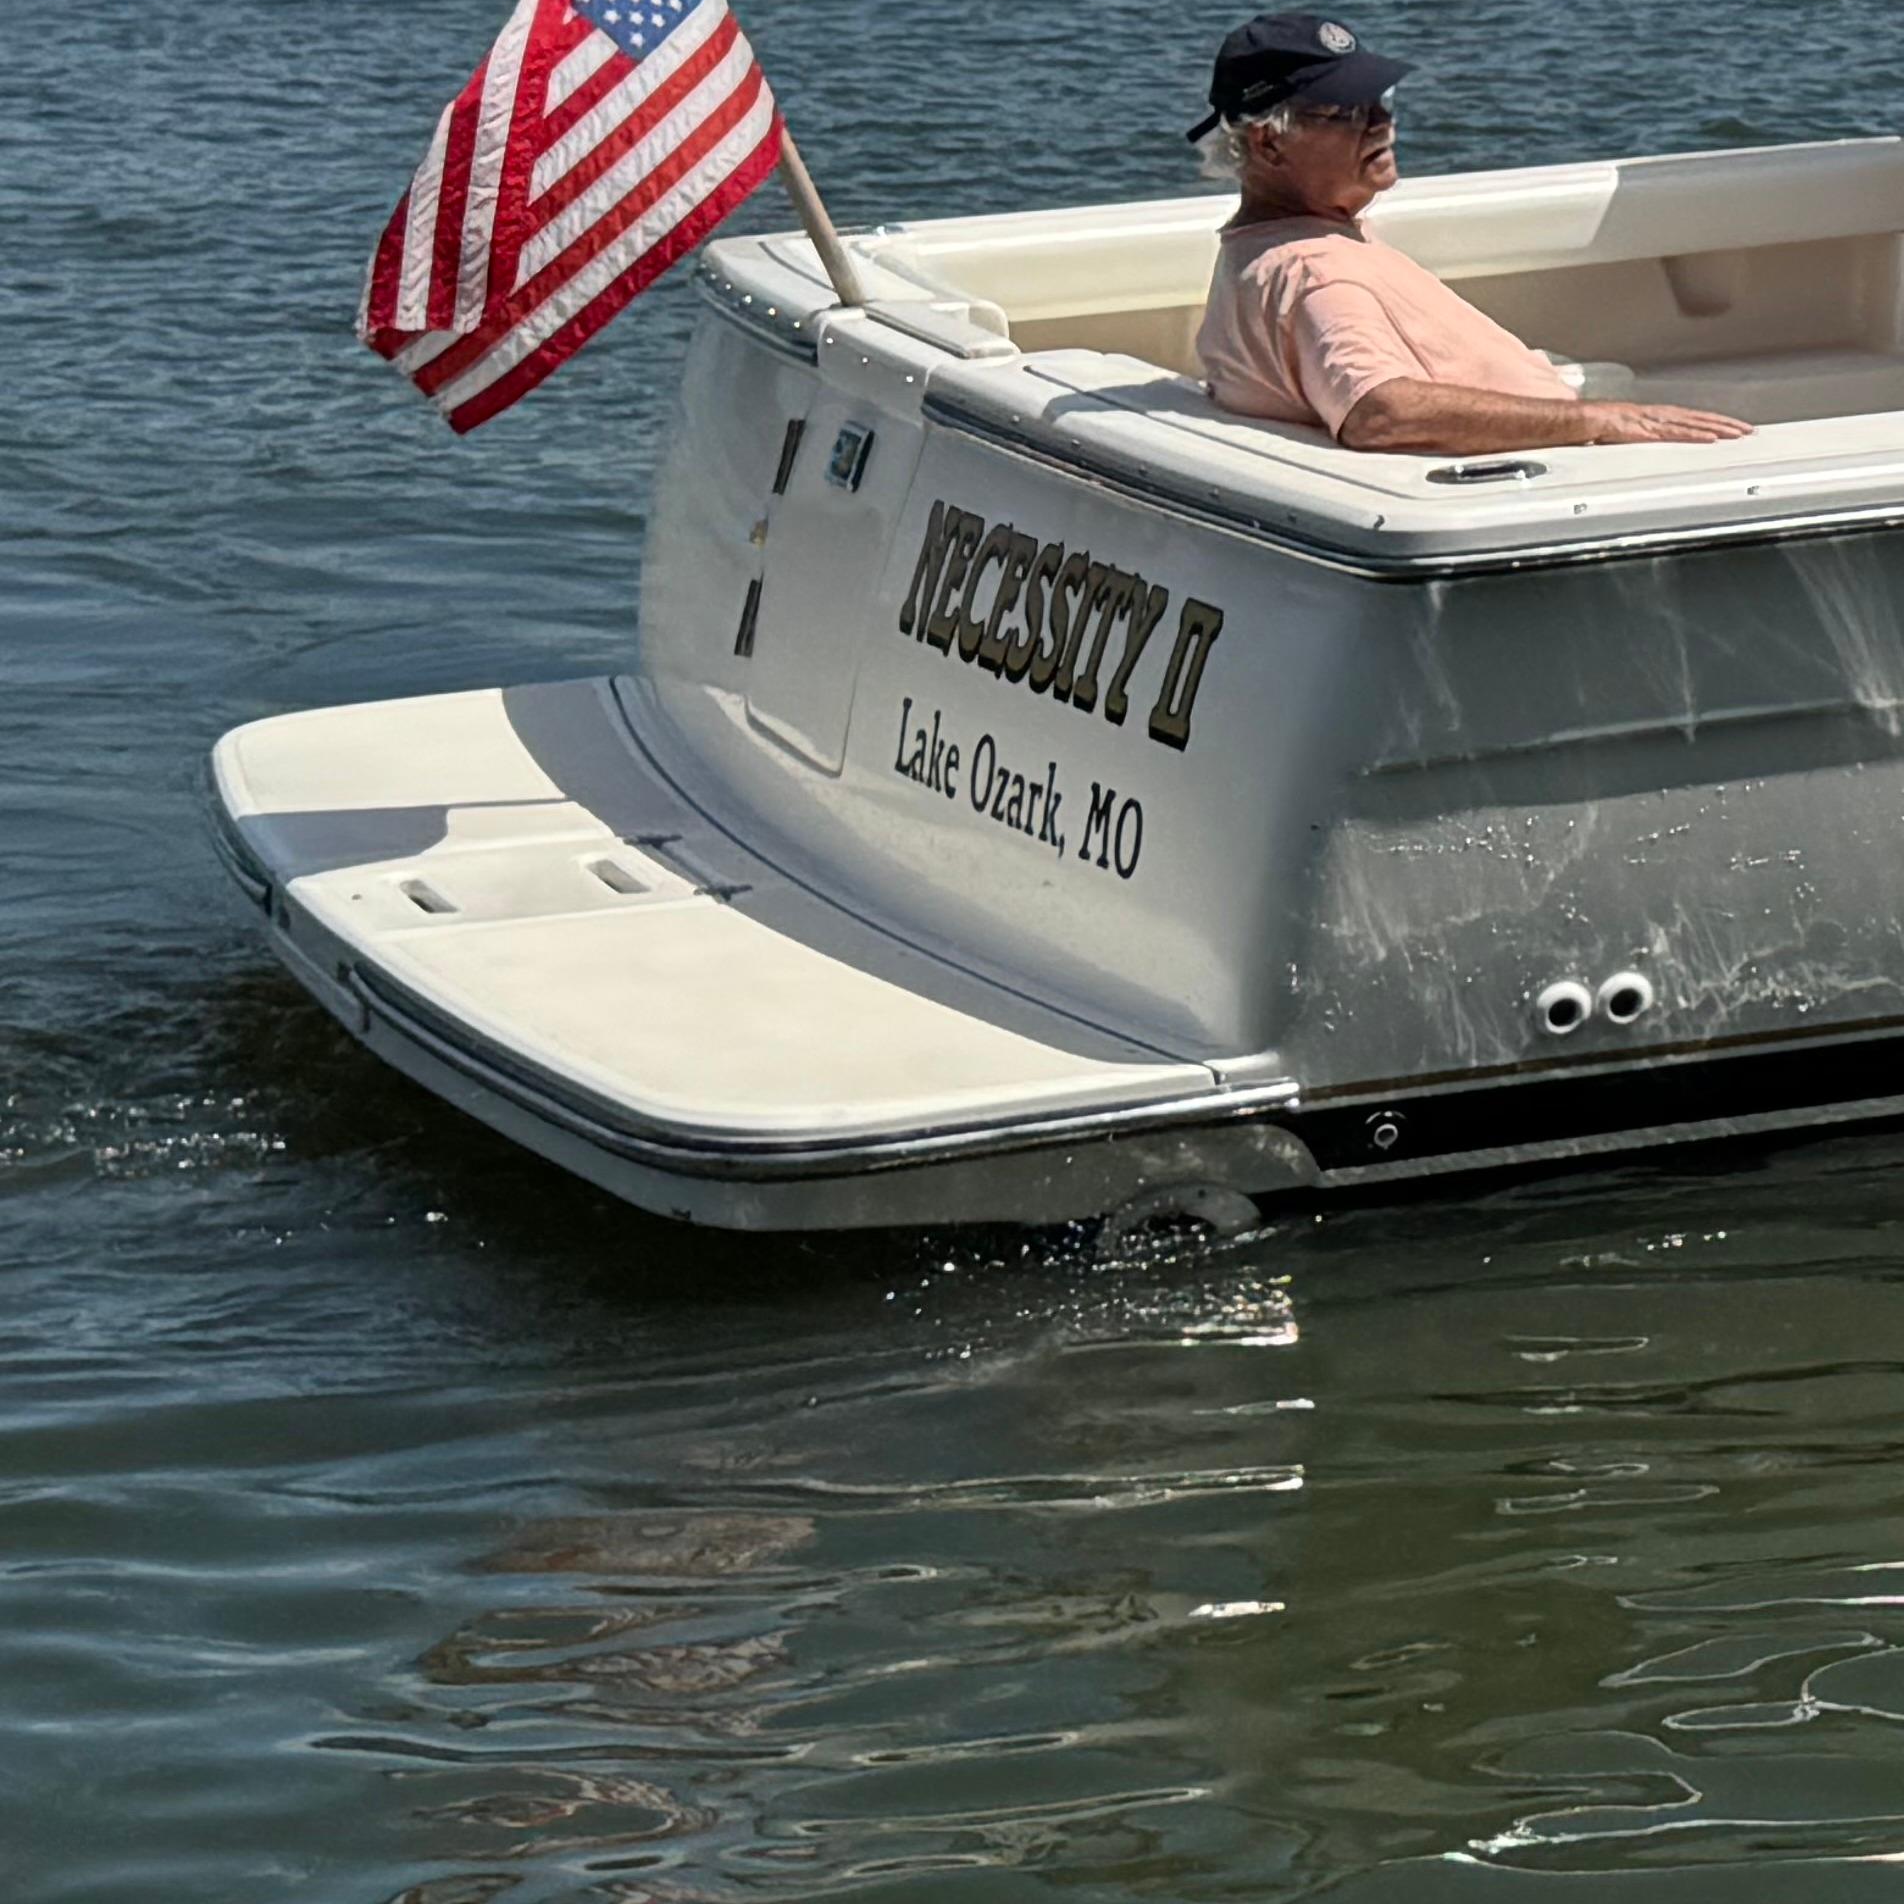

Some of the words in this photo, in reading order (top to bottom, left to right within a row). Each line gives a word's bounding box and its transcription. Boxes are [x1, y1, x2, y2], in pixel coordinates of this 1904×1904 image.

[899, 499, 1169, 726] NECESSITY
[894, 697, 960, 800] Lake
[970, 733, 1065, 859] Ozark,
[1078, 781, 1143, 880] MO
